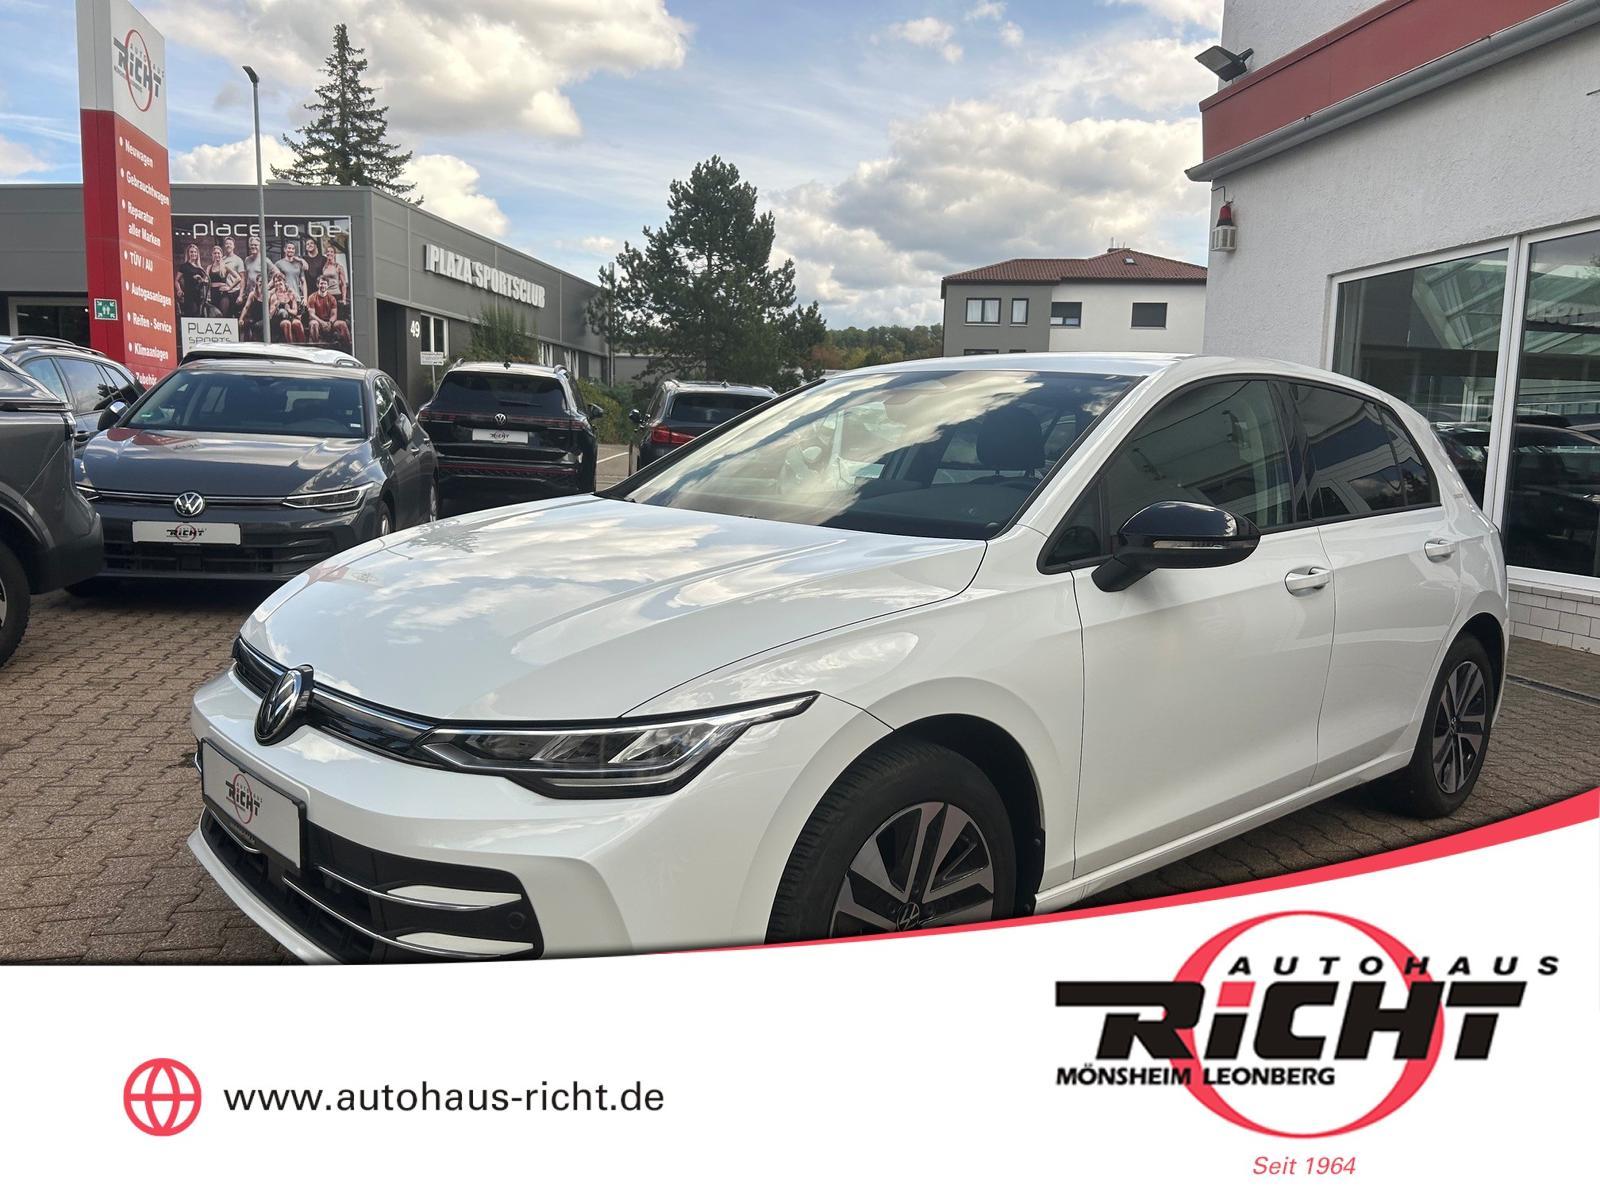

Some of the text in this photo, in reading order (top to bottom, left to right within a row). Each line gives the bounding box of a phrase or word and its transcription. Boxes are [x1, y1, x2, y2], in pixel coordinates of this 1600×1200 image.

[125, 139, 153, 168] Neuwagen
[127, 170, 169, 206] Gebrauchtwagen
[127, 201, 154, 225] Reparatur
[128, 223, 161, 247] aller Marken
[273, 220, 299, 238] to
[308, 221, 342, 238] be
[130, 251, 142, 268] TÜV
[145, 258, 153, 272] AU
[426, 243, 545, 308] PLAZA SPORTSCLUB
[131, 282, 171, 307] Autogasanlagen
[133, 312, 150, 328] Reifen
[153, 318, 172, 333] Service
[187, 322, 232, 335] PLAZA
[410, 321, 420, 338] 49
[134, 342, 169, 361] Klimaanlagen
